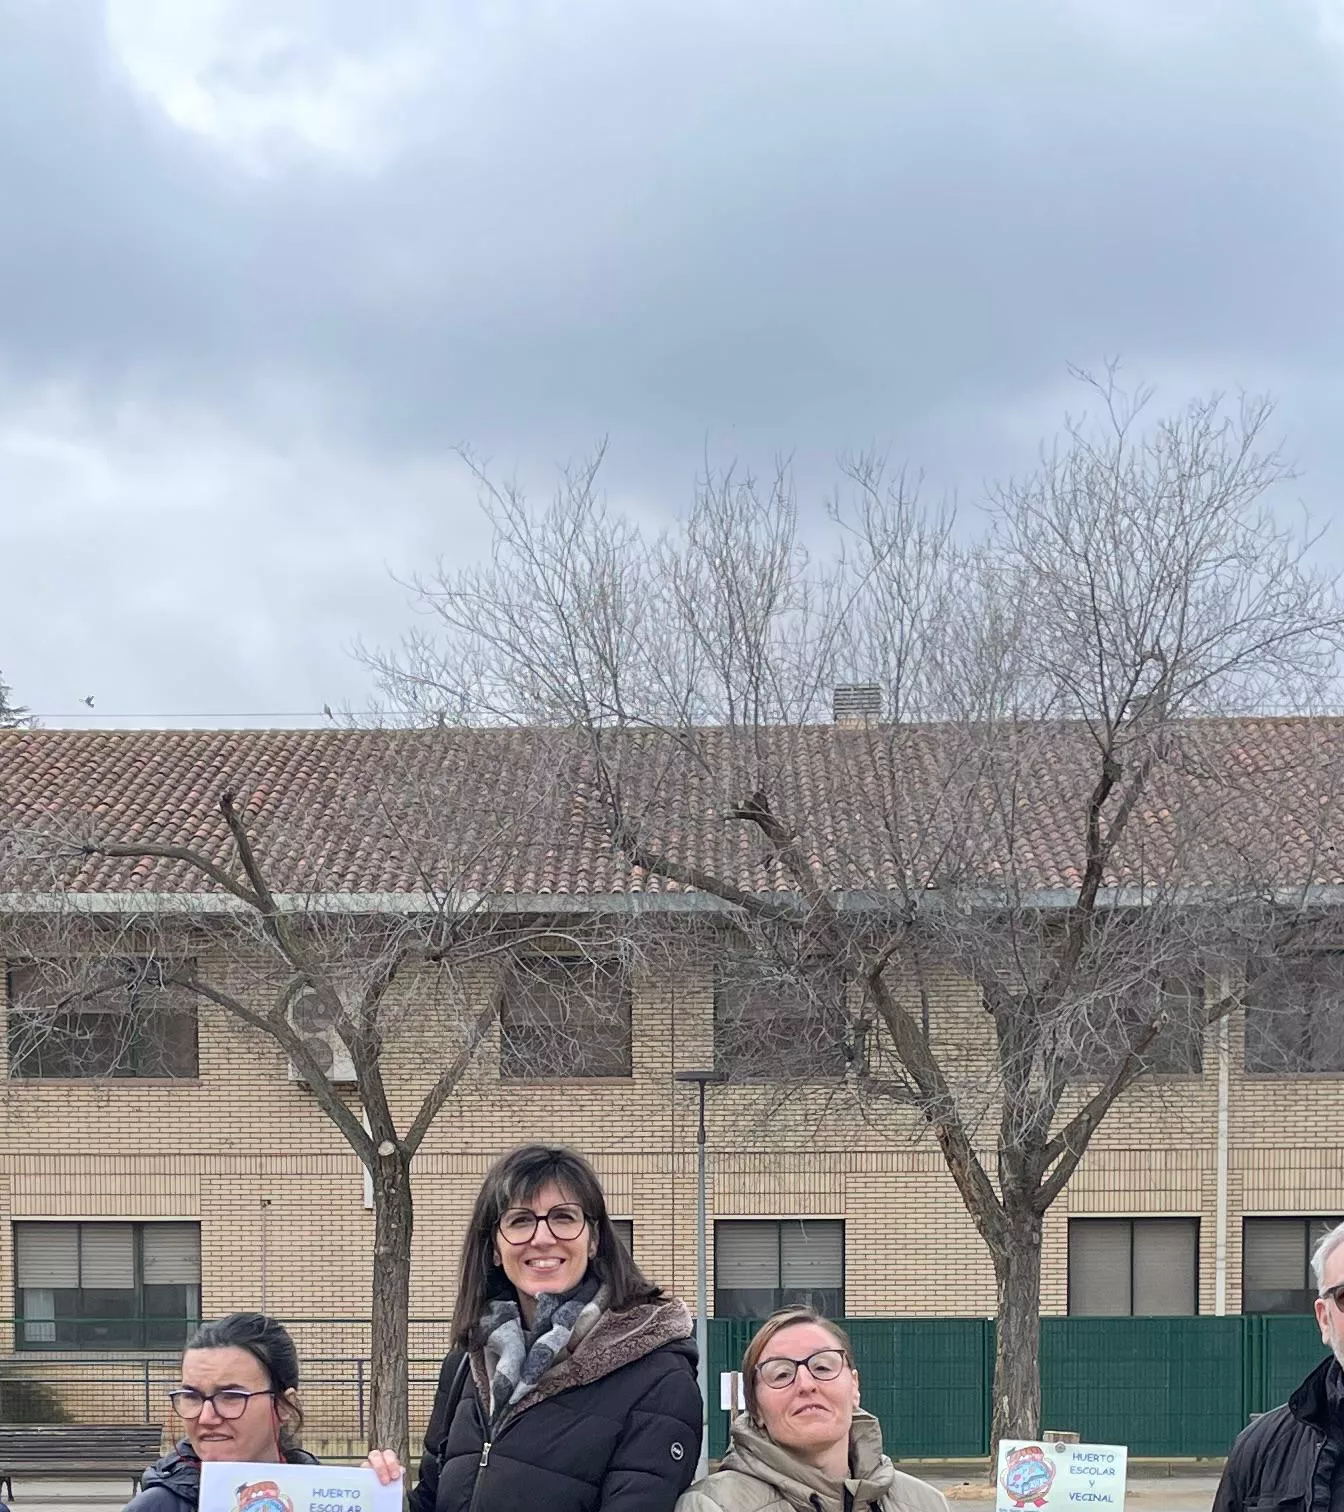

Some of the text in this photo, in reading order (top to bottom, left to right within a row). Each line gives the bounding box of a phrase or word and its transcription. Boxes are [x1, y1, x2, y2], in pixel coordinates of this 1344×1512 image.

[1072, 1452, 1115, 1463] HUERTO
[1070, 1466, 1116, 1476] ESCOLAR
[312, 1488, 361, 1499] HUERTO
[1069, 1492, 1114, 1503] VECINAL
